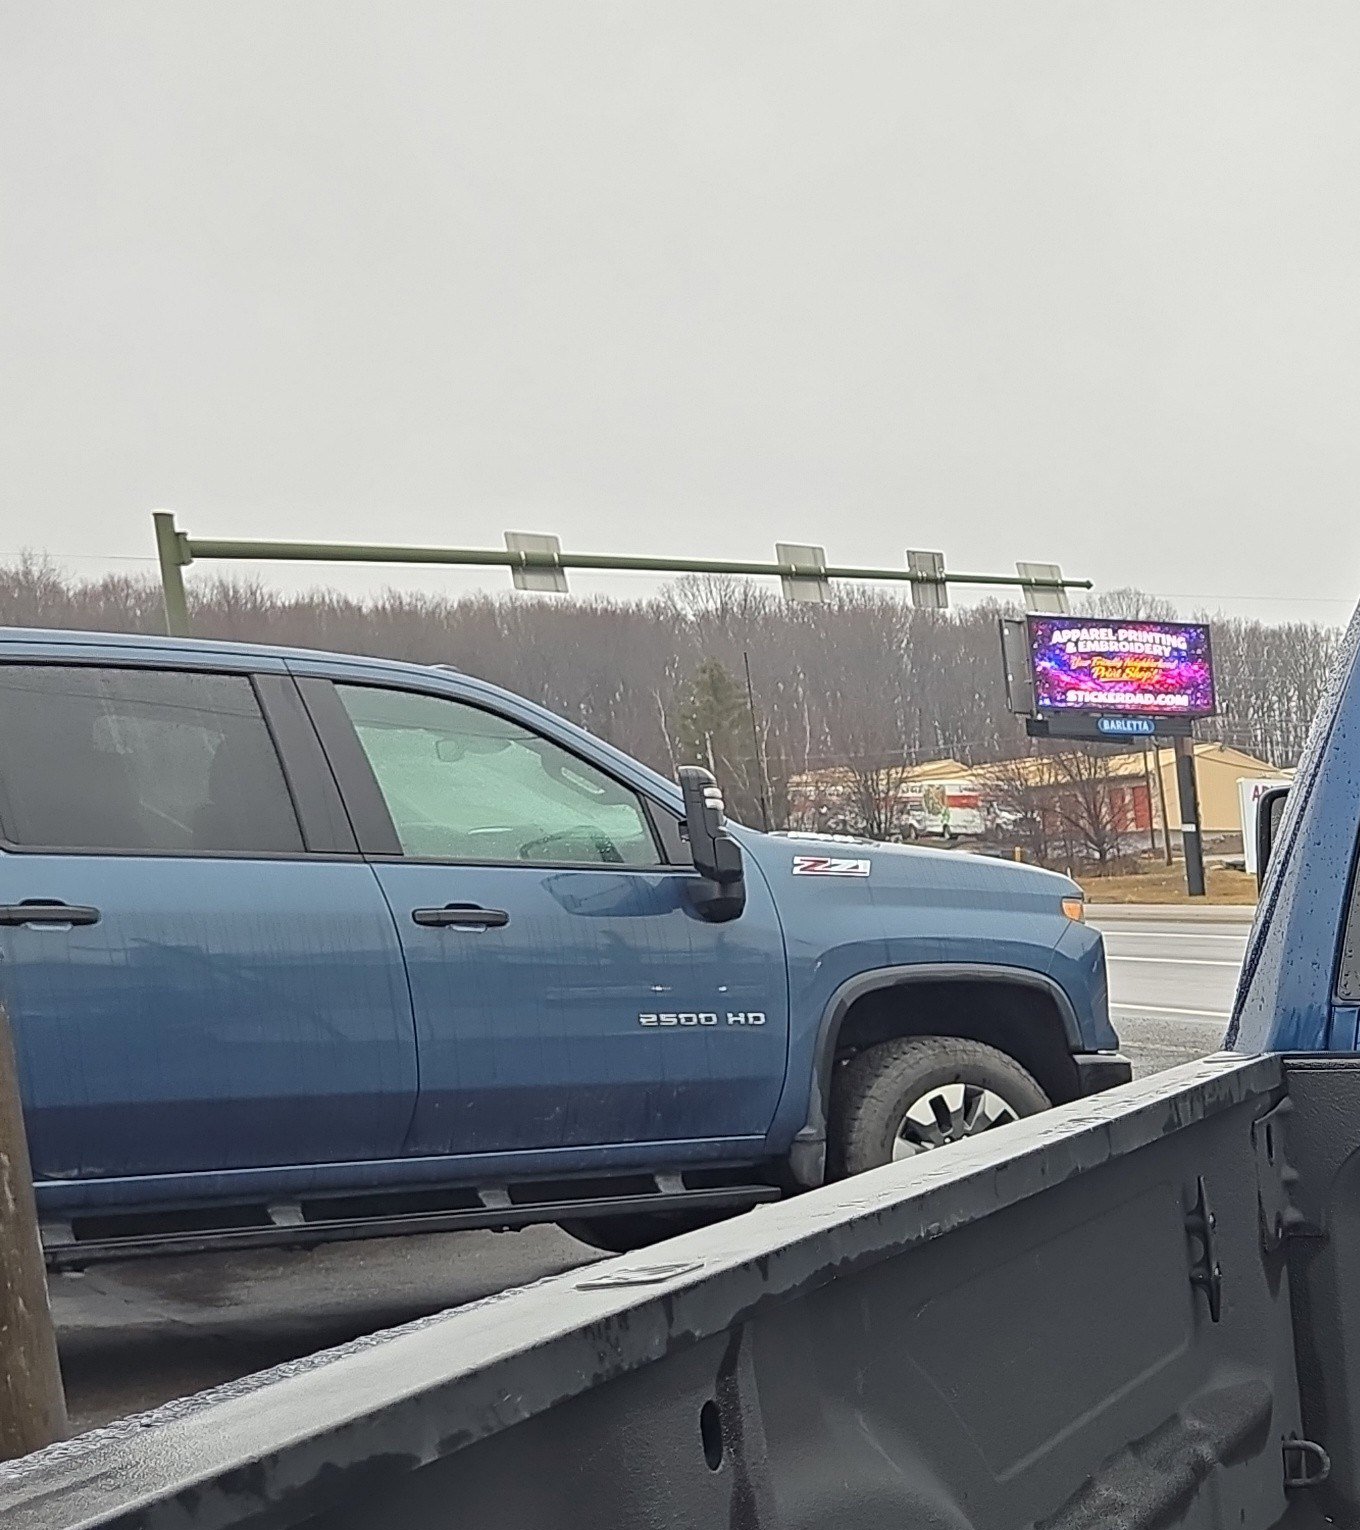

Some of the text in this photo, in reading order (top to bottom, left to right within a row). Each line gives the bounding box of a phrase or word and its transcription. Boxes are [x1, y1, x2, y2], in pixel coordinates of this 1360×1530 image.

[1050, 628, 1188, 650] APPAREL PRINTING
[1065, 640, 1172, 657] & EMBROIDERY
[1066, 690, 1189, 707] STICKERDAD.COM
[1103, 719, 1150, 732] BARLETTA
[792, 856, 871, 877] Z71
[639, 1012, 766, 1026] 2500 HD
